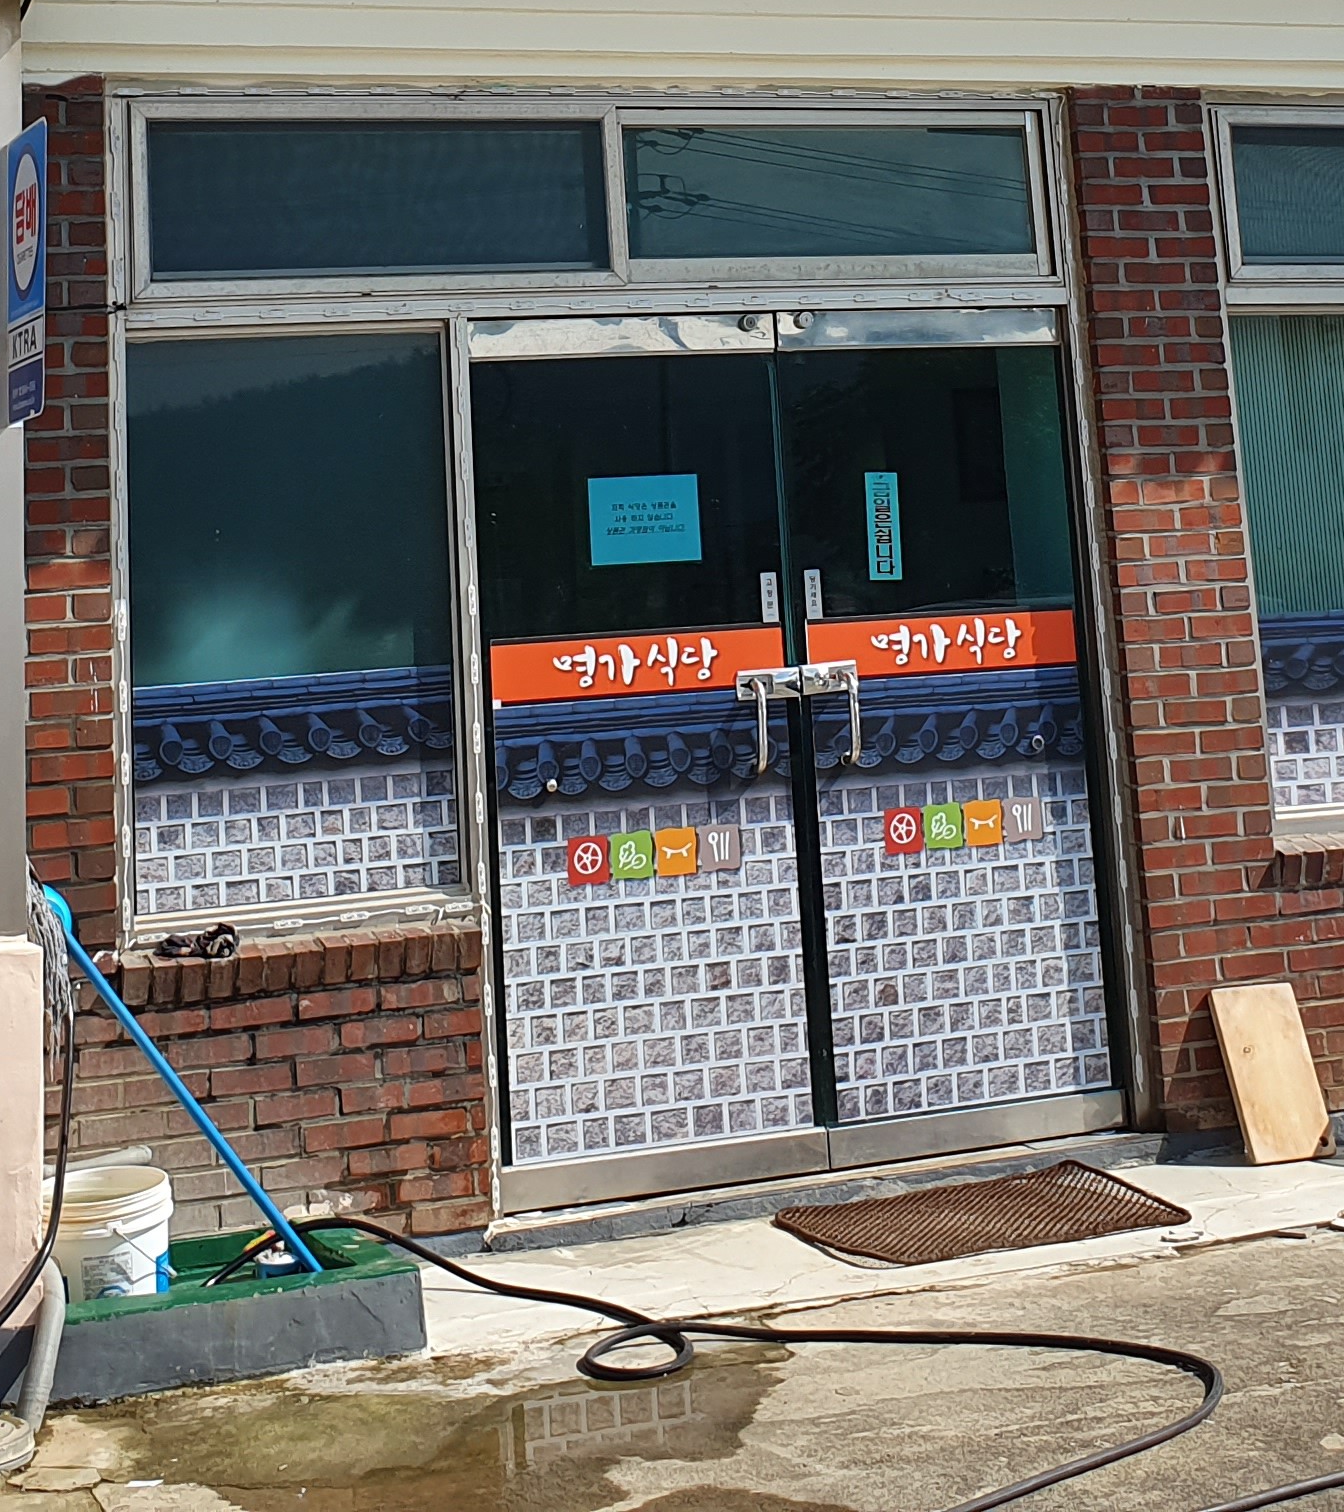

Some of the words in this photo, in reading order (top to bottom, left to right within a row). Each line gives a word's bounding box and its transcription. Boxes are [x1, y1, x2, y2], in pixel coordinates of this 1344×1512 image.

[15, 182, 37, 245] 담배
[12, 325, 37, 359] KTRA
[552, 637, 718, 687] 명가식당
[870, 617, 1022, 665] 명가식당
